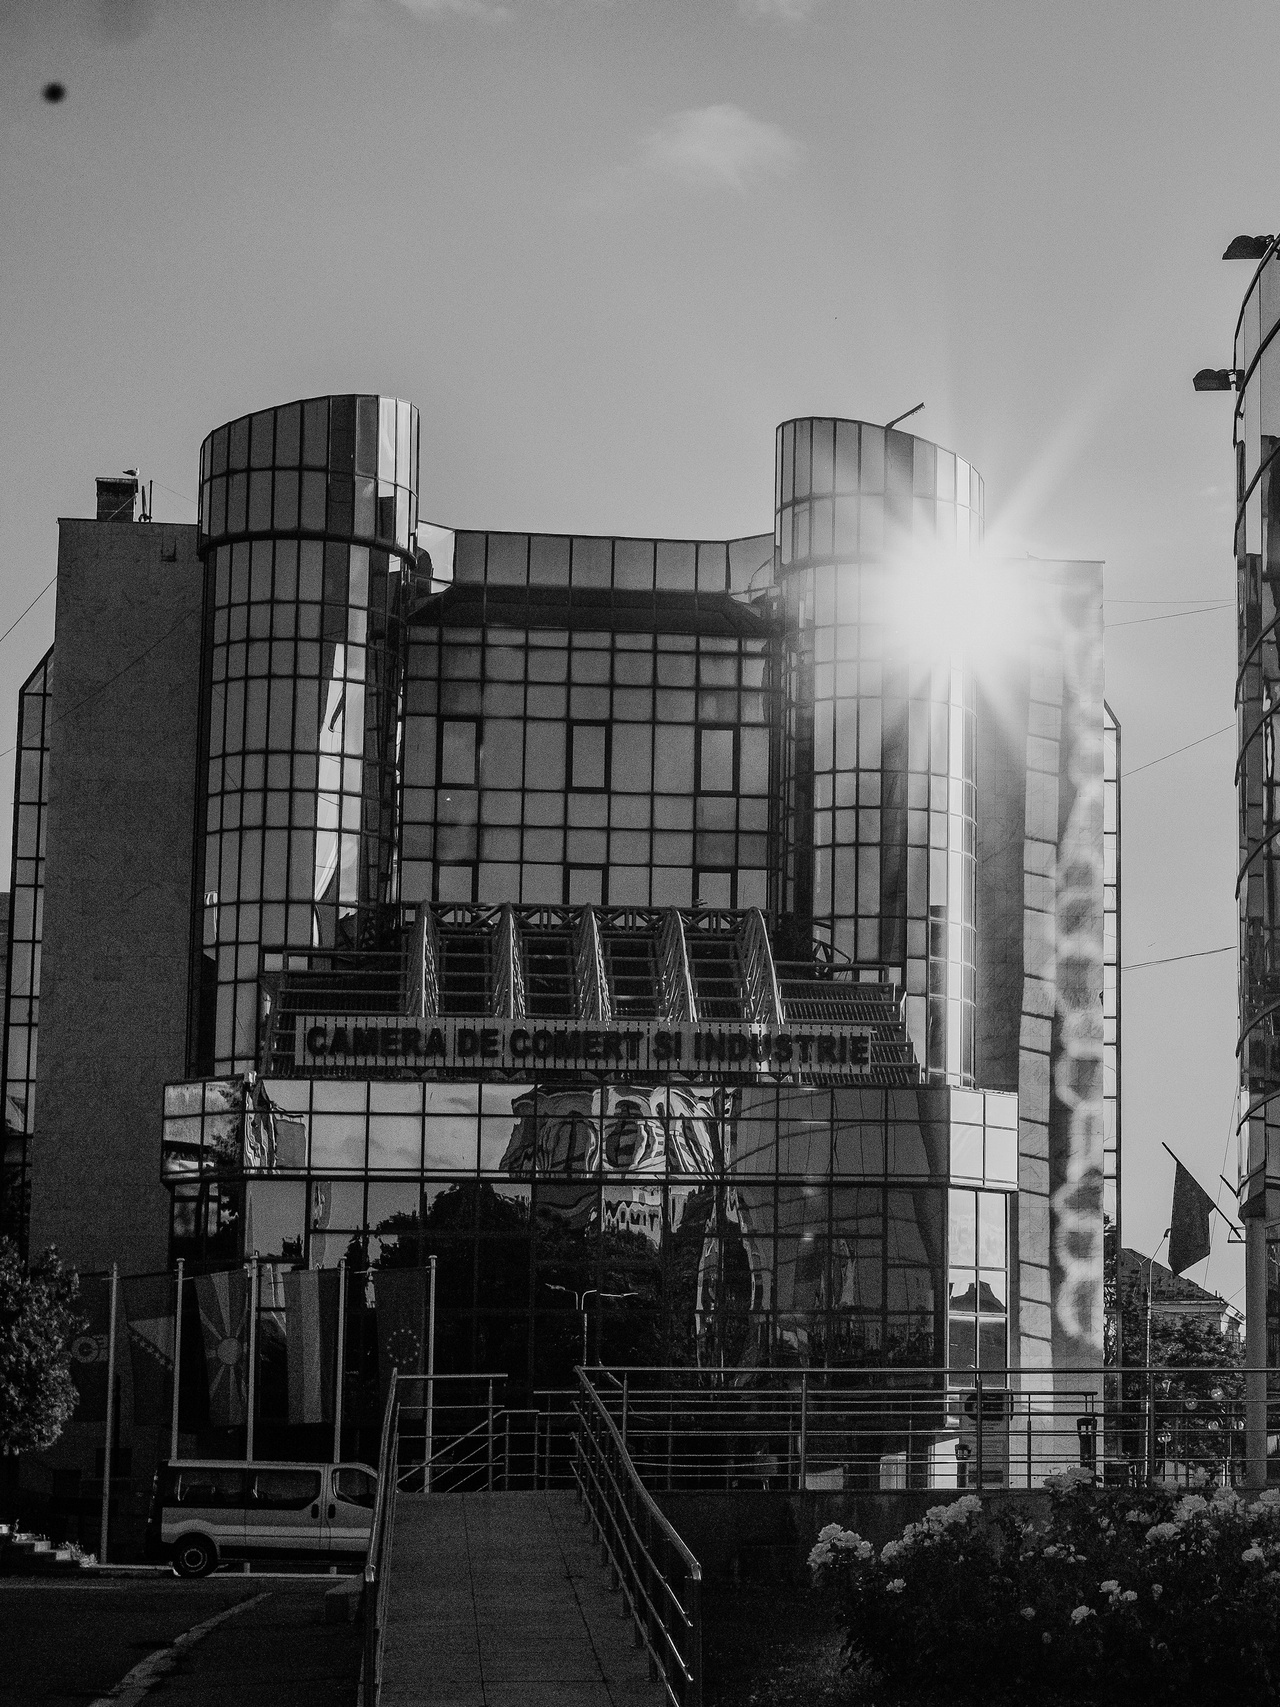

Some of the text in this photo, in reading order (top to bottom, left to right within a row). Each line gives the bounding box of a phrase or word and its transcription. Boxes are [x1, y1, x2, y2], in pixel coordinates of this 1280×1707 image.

[307, 1026, 869, 1065] CAMERA DE COMERT SI INDUSTRIE
